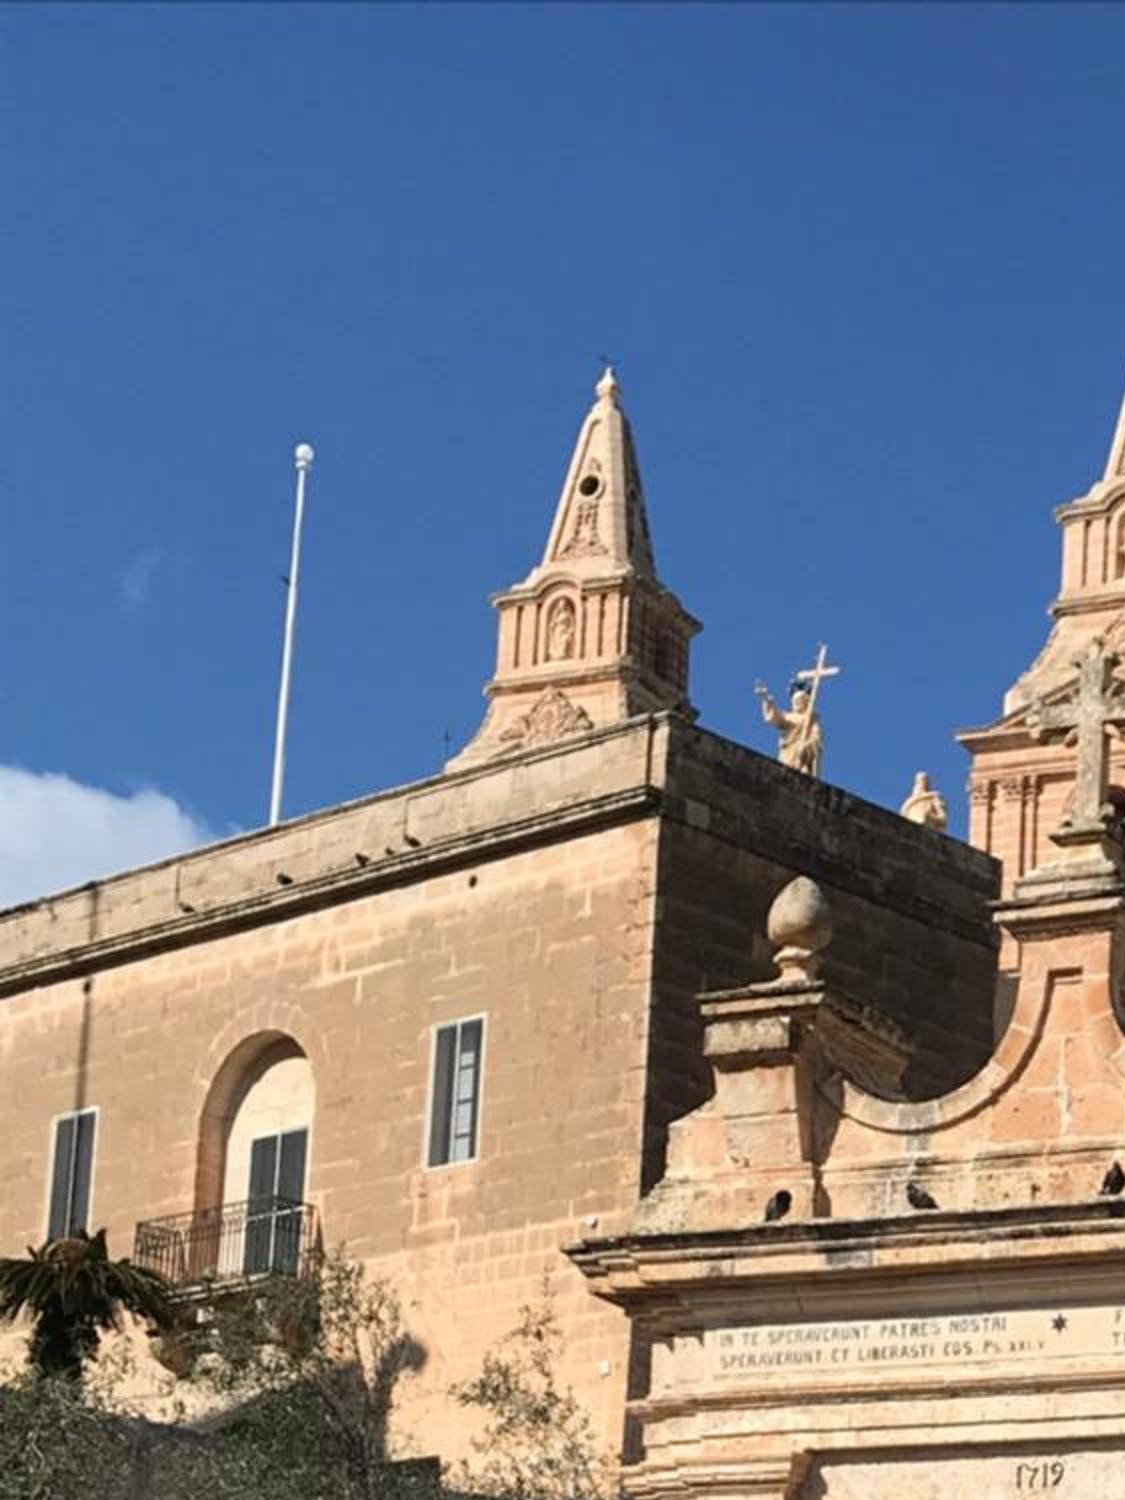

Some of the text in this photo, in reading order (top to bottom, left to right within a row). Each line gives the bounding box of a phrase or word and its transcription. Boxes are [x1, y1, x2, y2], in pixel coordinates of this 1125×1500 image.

[879, 1320, 942, 1339] PATRES
[948, 1316, 1007, 1334] NOSTRI
[1015, 1461, 1066, 1489] 1719
